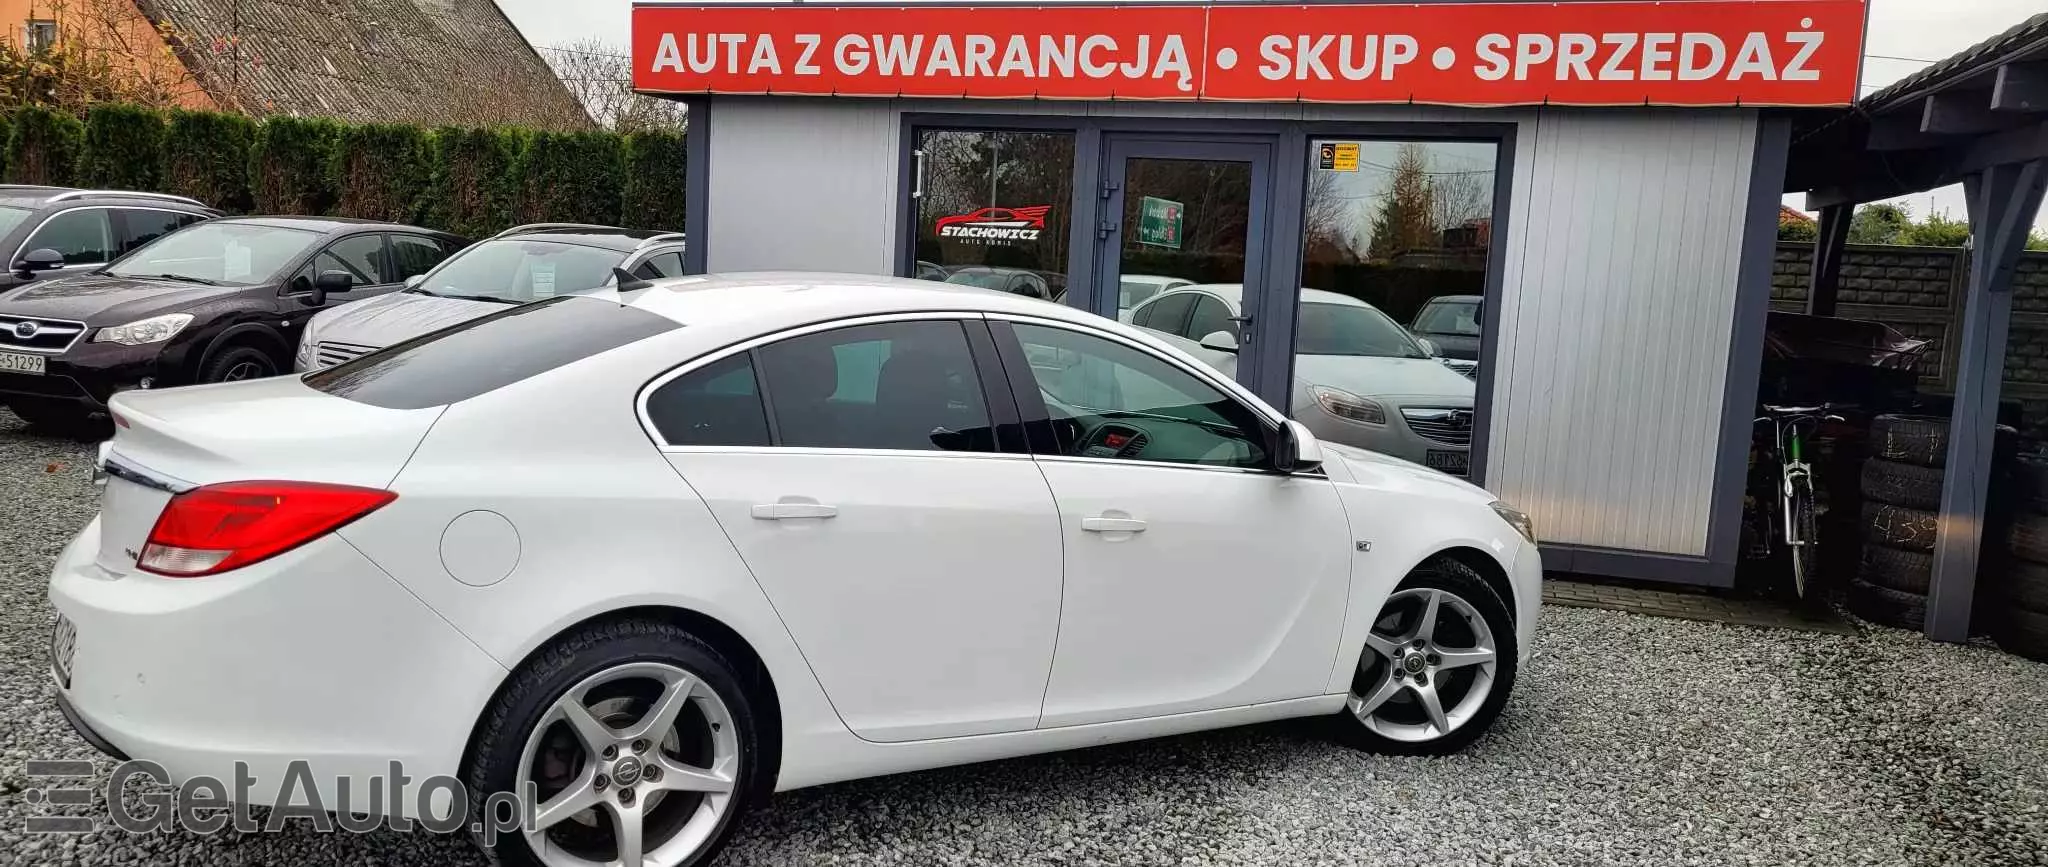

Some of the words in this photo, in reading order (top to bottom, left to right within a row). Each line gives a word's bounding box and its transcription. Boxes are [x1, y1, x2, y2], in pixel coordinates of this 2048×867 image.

[652, 33, 782, 75] AUTA
[794, 34, 821, 75] Z
[833, 34, 1193, 91] GWARANCJĄ
[1258, 34, 1419, 81] SKUP
[1474, 17, 1825, 81] SPRZEDAŻ
[940, 226, 1040, 240] STACHOWICZ
